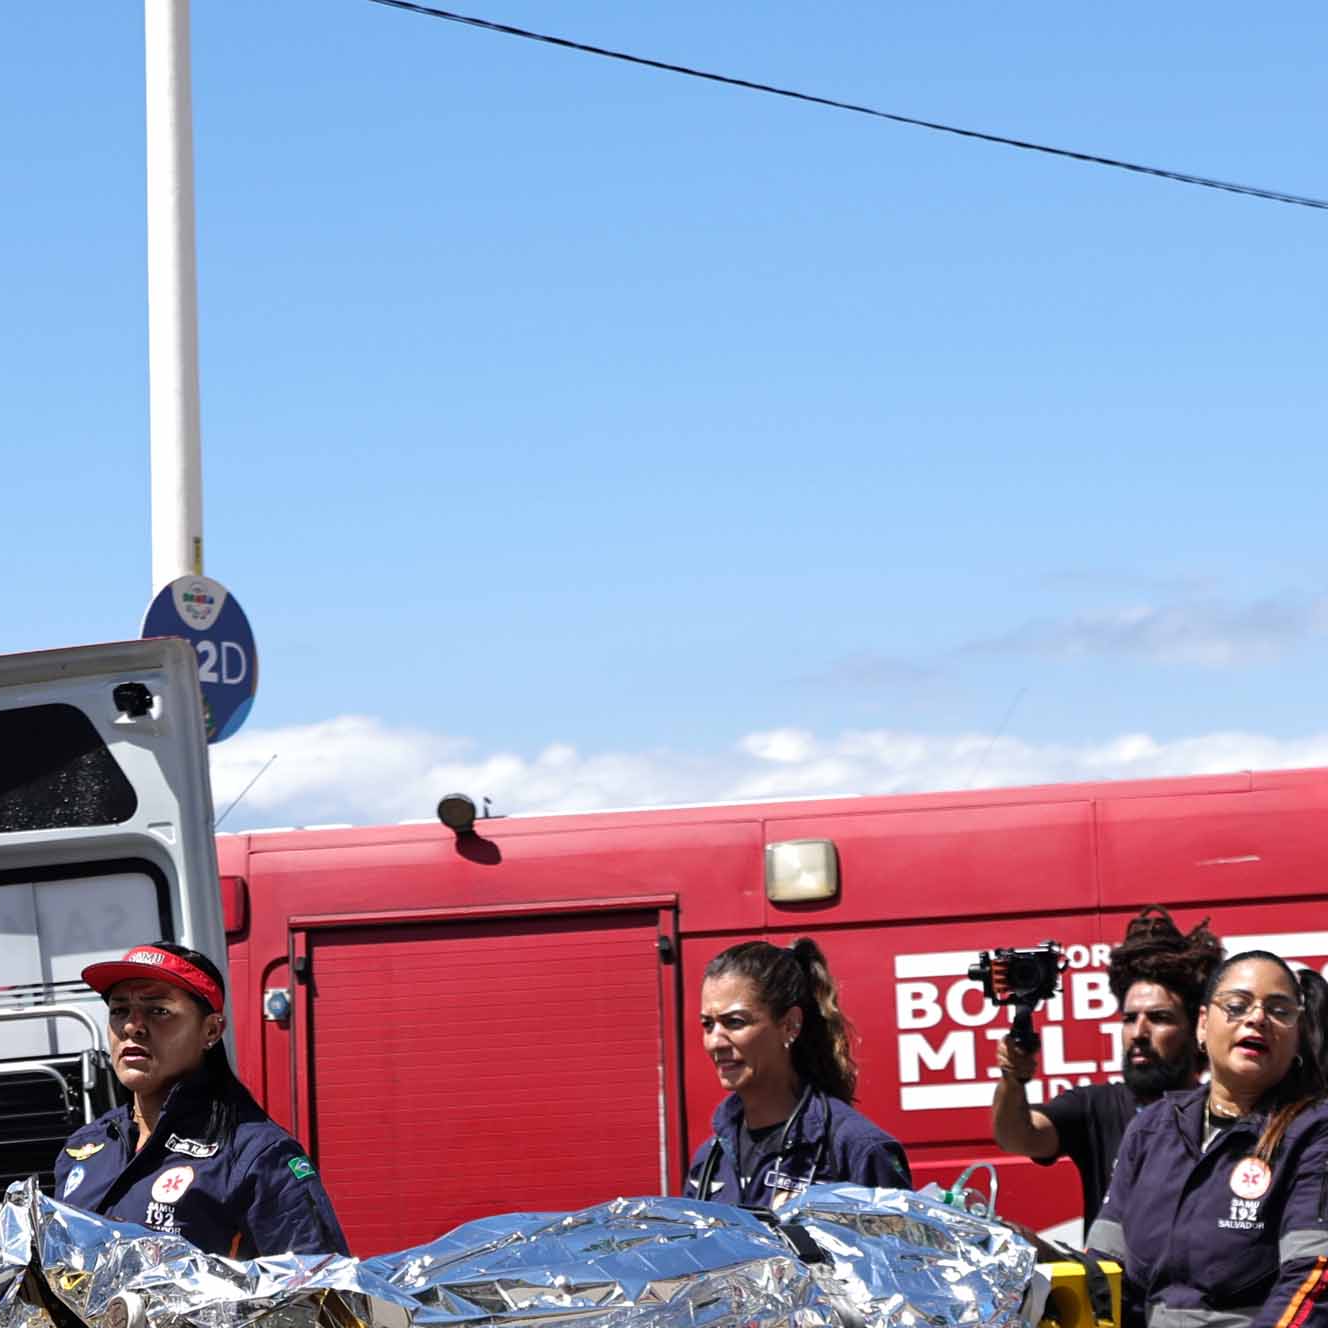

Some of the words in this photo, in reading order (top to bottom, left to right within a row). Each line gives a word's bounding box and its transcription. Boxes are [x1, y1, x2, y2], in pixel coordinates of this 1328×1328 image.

[1231, 1198, 1260, 1208] SAMU
[145, 1210, 174, 1227] 192
[1230, 1206, 1257, 1221] 192
[1216, 1219, 1265, 1230] SALVADOR
